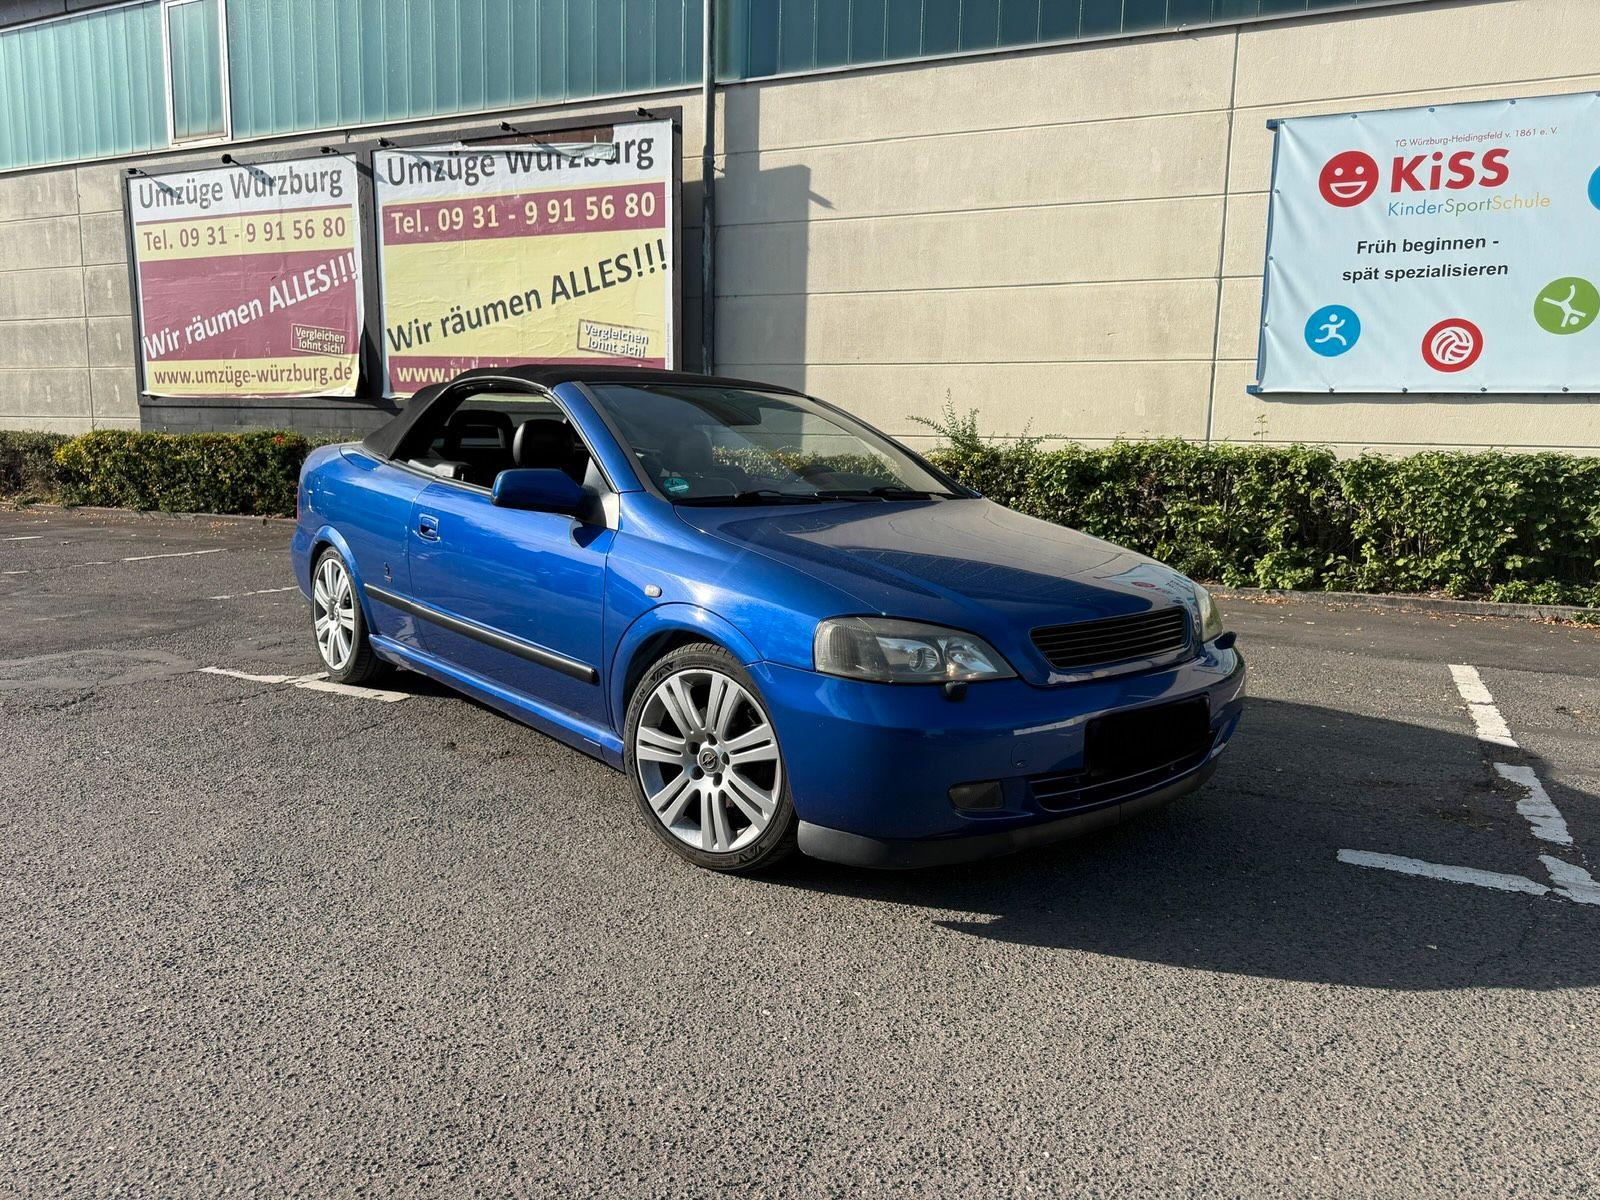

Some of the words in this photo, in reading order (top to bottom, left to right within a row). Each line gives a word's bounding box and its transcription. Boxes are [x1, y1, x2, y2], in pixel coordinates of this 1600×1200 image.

[1396, 138, 1407, 148] TG
[1409, 131, 1503, 147] Würzburg-Heidingsfeld
[1515, 128, 1536, 137] 1861
[387, 151, 495, 186] Umzüge
[1391, 148, 1510, 192] KiSS
[139, 179, 224, 209] Umzüge
[230, 166, 343, 198] Würzburg
[391, 209, 429, 234] Tel.
[438, 207, 464, 231] 09
[472, 204, 499, 228] 31
[524, 201, 538, 225] 9
[547, 198, 575, 223] 91
[586, 195, 615, 219] 56
[624, 191, 656, 218] 80
[1388, 192, 1551, 217] KinderSportSchule
[143, 229, 173, 251] Tel.
[180, 229, 200, 248] 09
[207, 226, 227, 246] 31
[246, 223, 257, 243] 9
[263, 220, 285, 241] 91
[293, 218, 315, 240] 56
[323, 216, 346, 238] 80
[1357, 239, 1396, 254] Früh
[1402, 236, 1486, 256] beginnen
[1342, 266, 1380, 284] spät
[1384, 262, 1509, 283] spezialisieren
[143, 328, 180, 359] Wir
[185, 298, 263, 345] räumen
[269, 252, 358, 313] ALLES!!!
[387, 319, 432, 352] Wir
[441, 289, 542, 338] räumen
[551, 238, 668, 305] ALLES!!!
[295, 327, 346, 344] Vergleichen
[299, 337, 322, 351] lohnt
[323, 342, 345, 354] sich!
[585, 323, 649, 345] Vergleichen
[589, 336, 617, 352] lohnt
[620, 343, 646, 358] sich!
[154, 362, 353, 388] www.umzüge-würzburg.de
